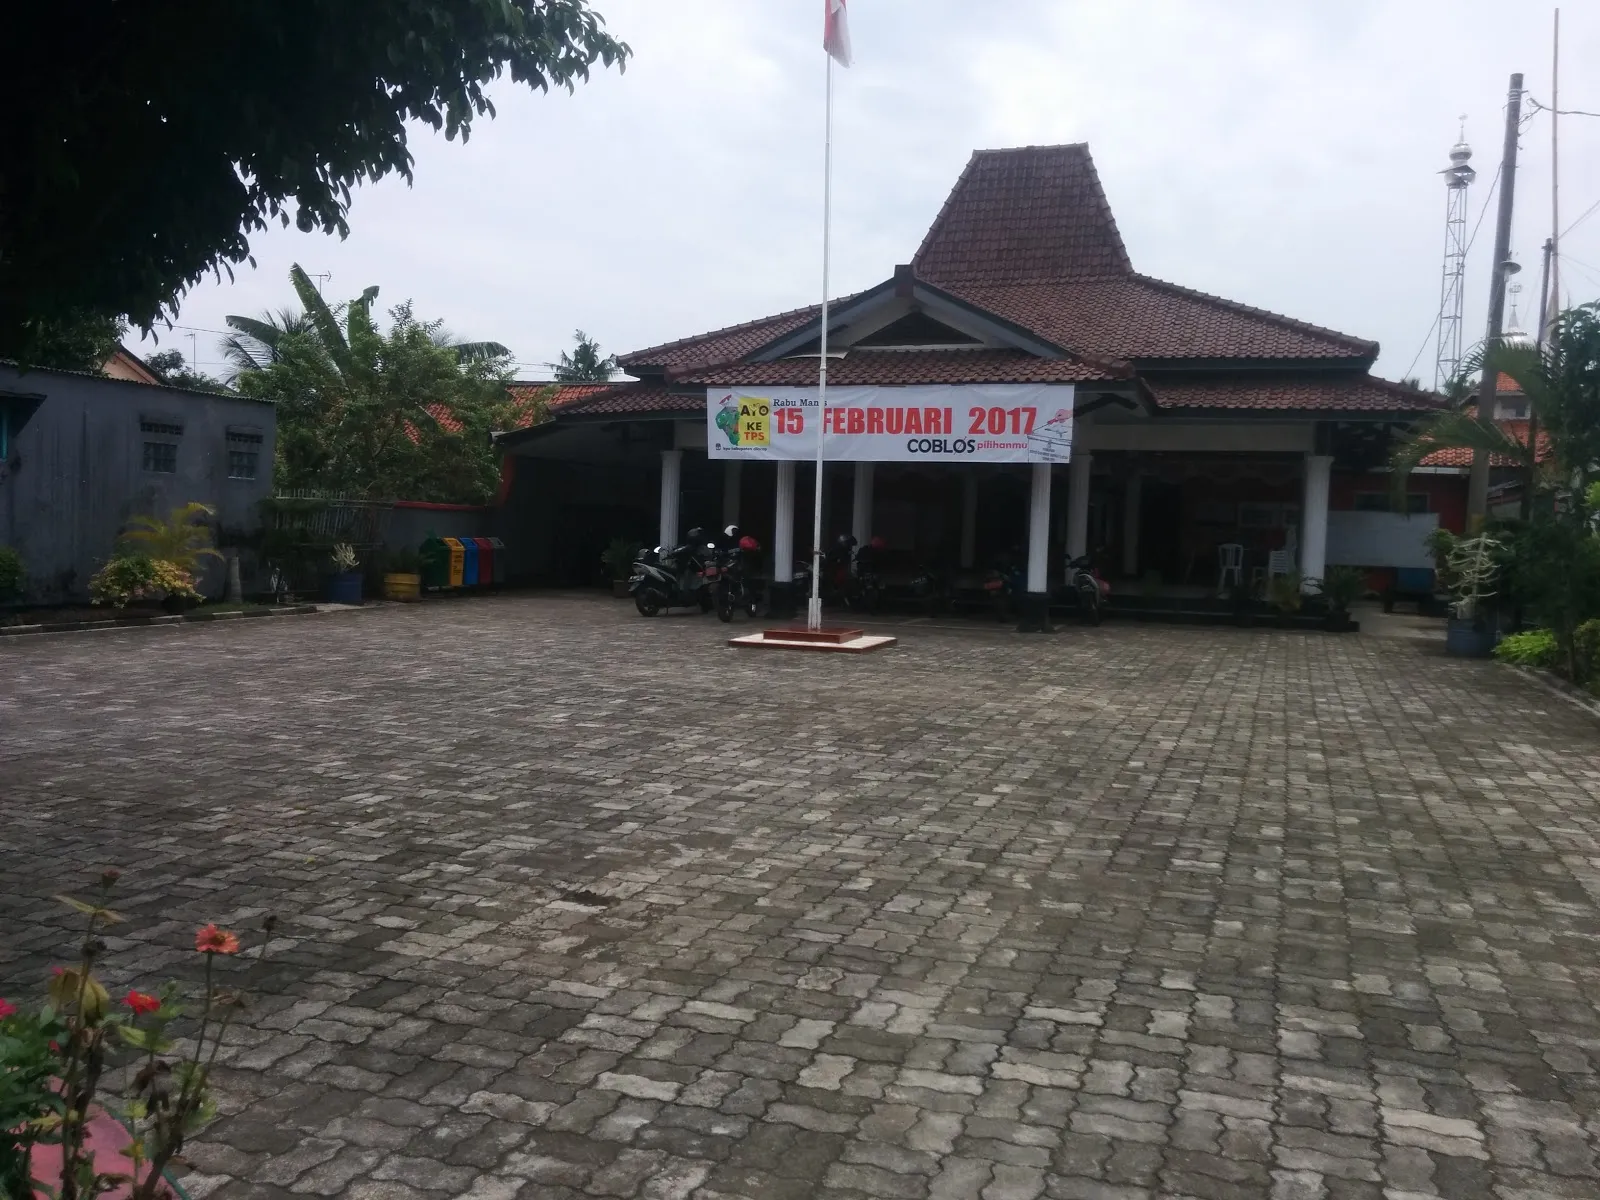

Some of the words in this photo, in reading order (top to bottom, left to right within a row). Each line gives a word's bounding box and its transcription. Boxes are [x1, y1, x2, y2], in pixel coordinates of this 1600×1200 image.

[741, 405, 769, 416] AYO
[746, 422, 762, 431] KE
[774, 407, 804, 434] 15
[823, 407, 952, 435] FEBRUARI
[968, 407, 1037, 435] 2017
[744, 432, 765, 441] TPS
[977, 440, 1028, 451] pilihanmu
